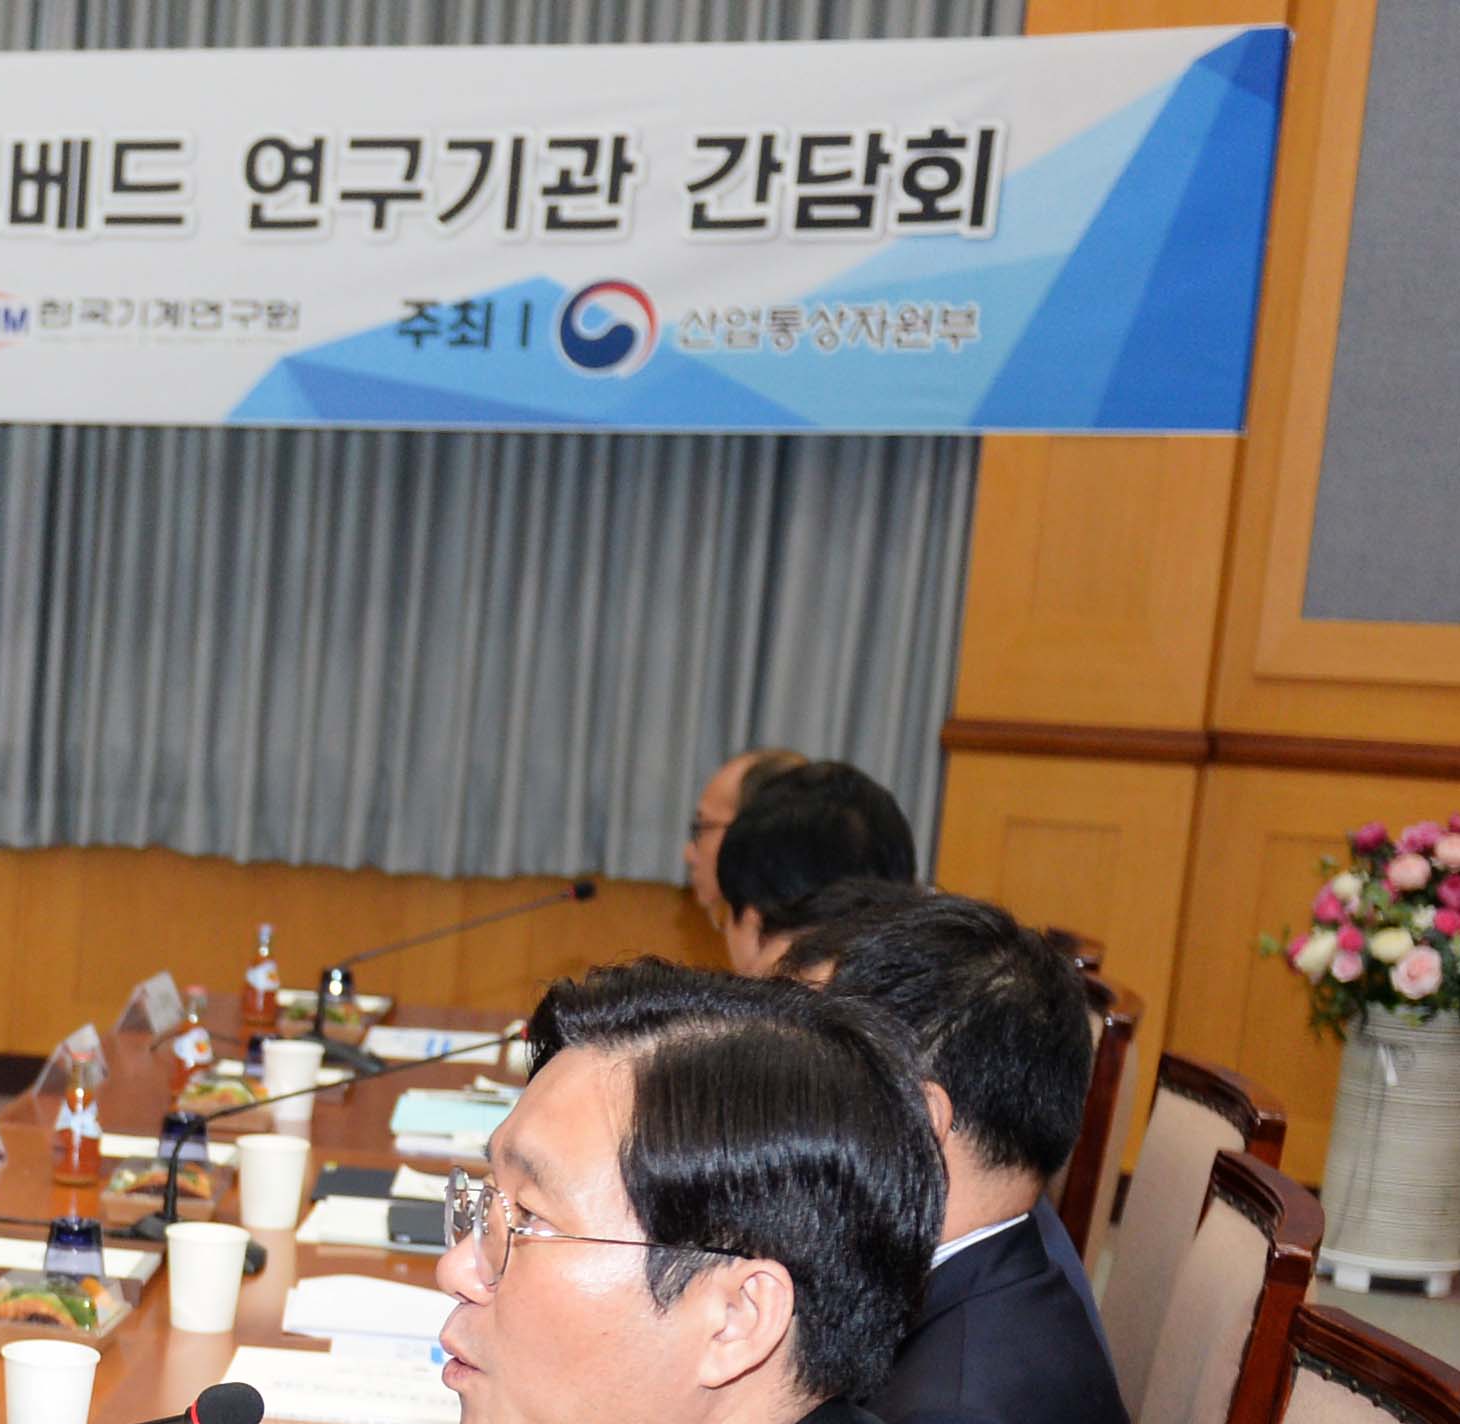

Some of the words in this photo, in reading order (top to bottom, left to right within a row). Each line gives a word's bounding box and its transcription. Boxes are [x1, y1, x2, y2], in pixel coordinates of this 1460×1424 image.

[245, 135, 635, 231] 연구기관
[686, 128, 995, 230] 간담회
[39, 298, 300, 331] 한국기계연구원
[397, 299, 496, 350] 주최
[680, 303, 978, 351] 산업통상자원부
